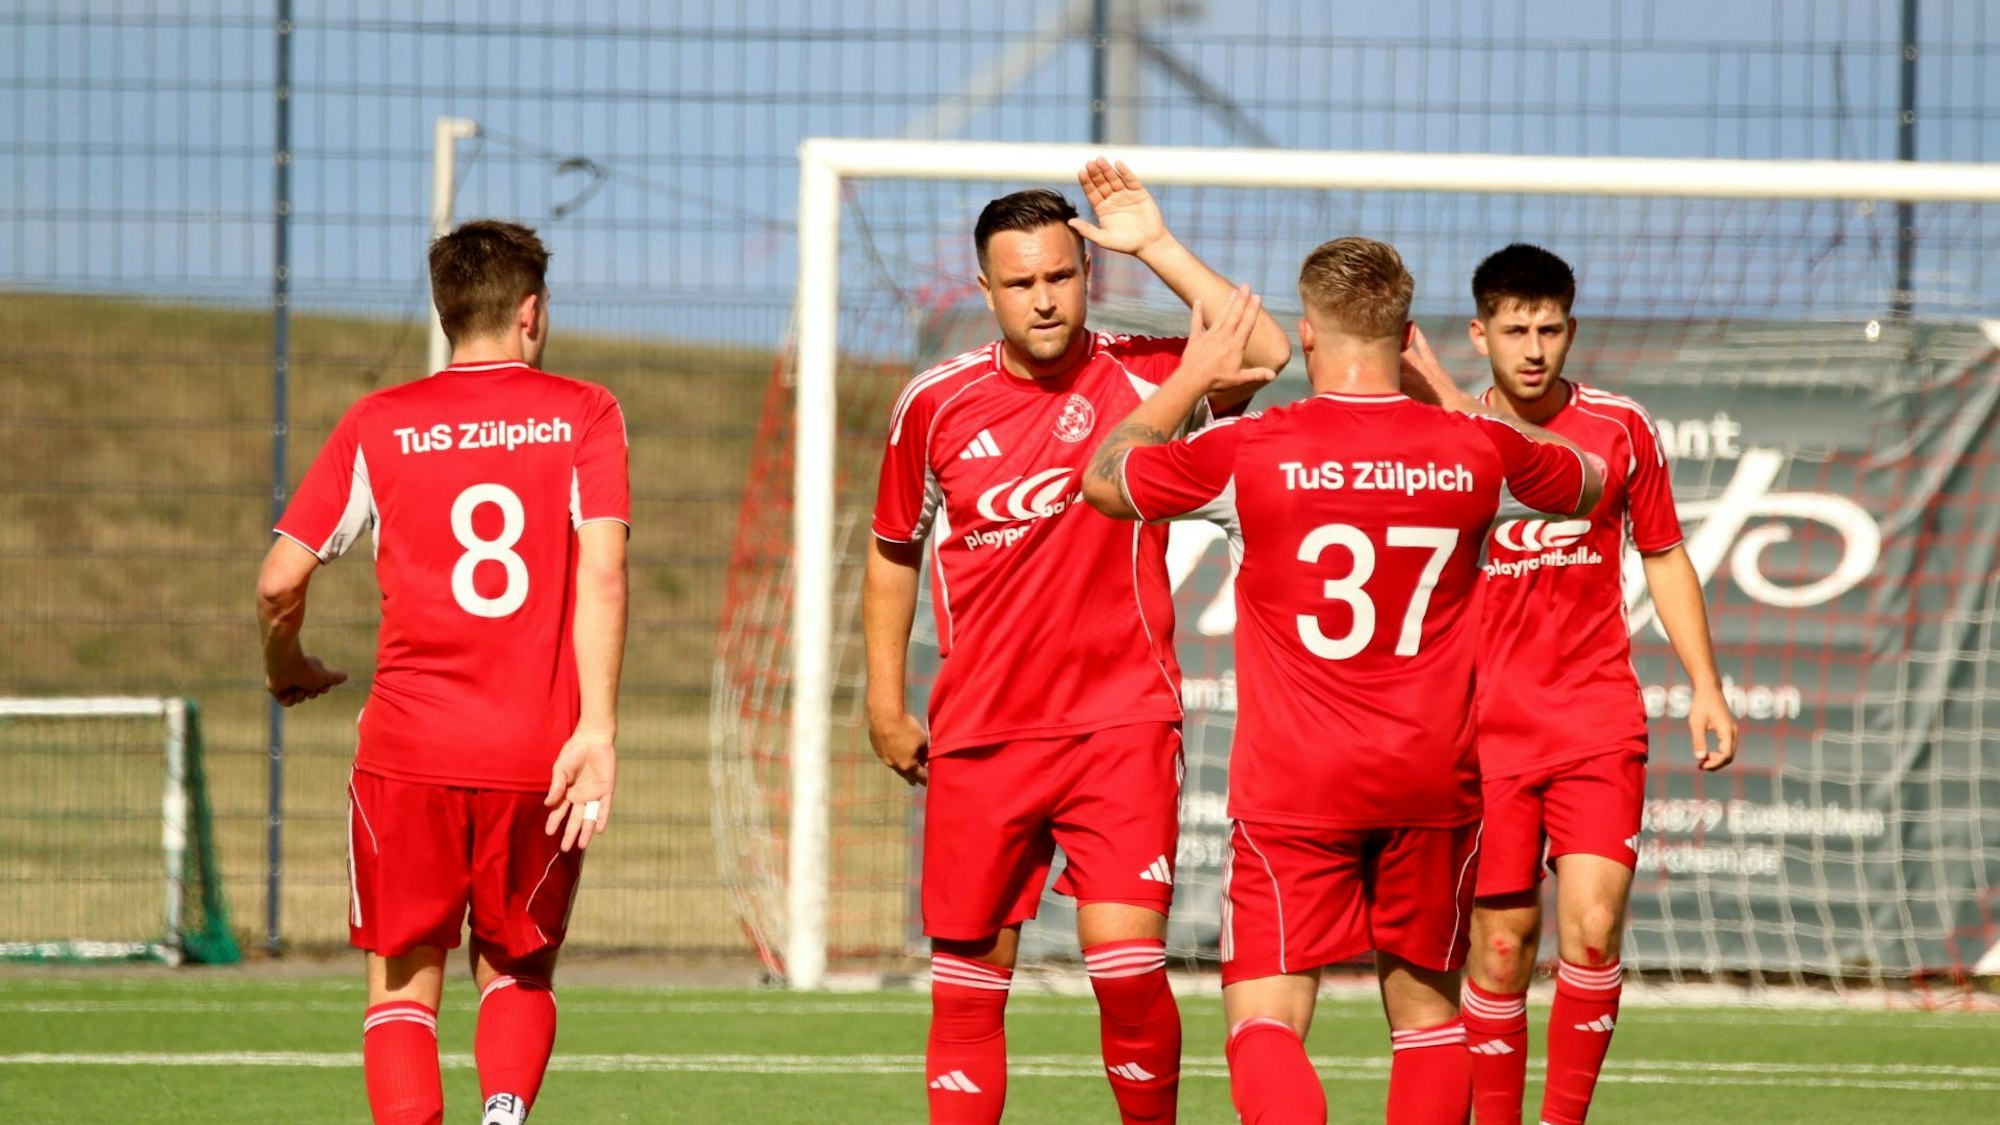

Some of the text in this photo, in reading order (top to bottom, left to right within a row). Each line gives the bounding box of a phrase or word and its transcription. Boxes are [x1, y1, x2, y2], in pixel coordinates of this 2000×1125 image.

[393, 417, 572, 455] TuS Zülpich
[1278, 461, 1474, 496] TuS Zülpich
[450, 483, 529, 618] 8
[1296, 523, 1460, 660] 37
